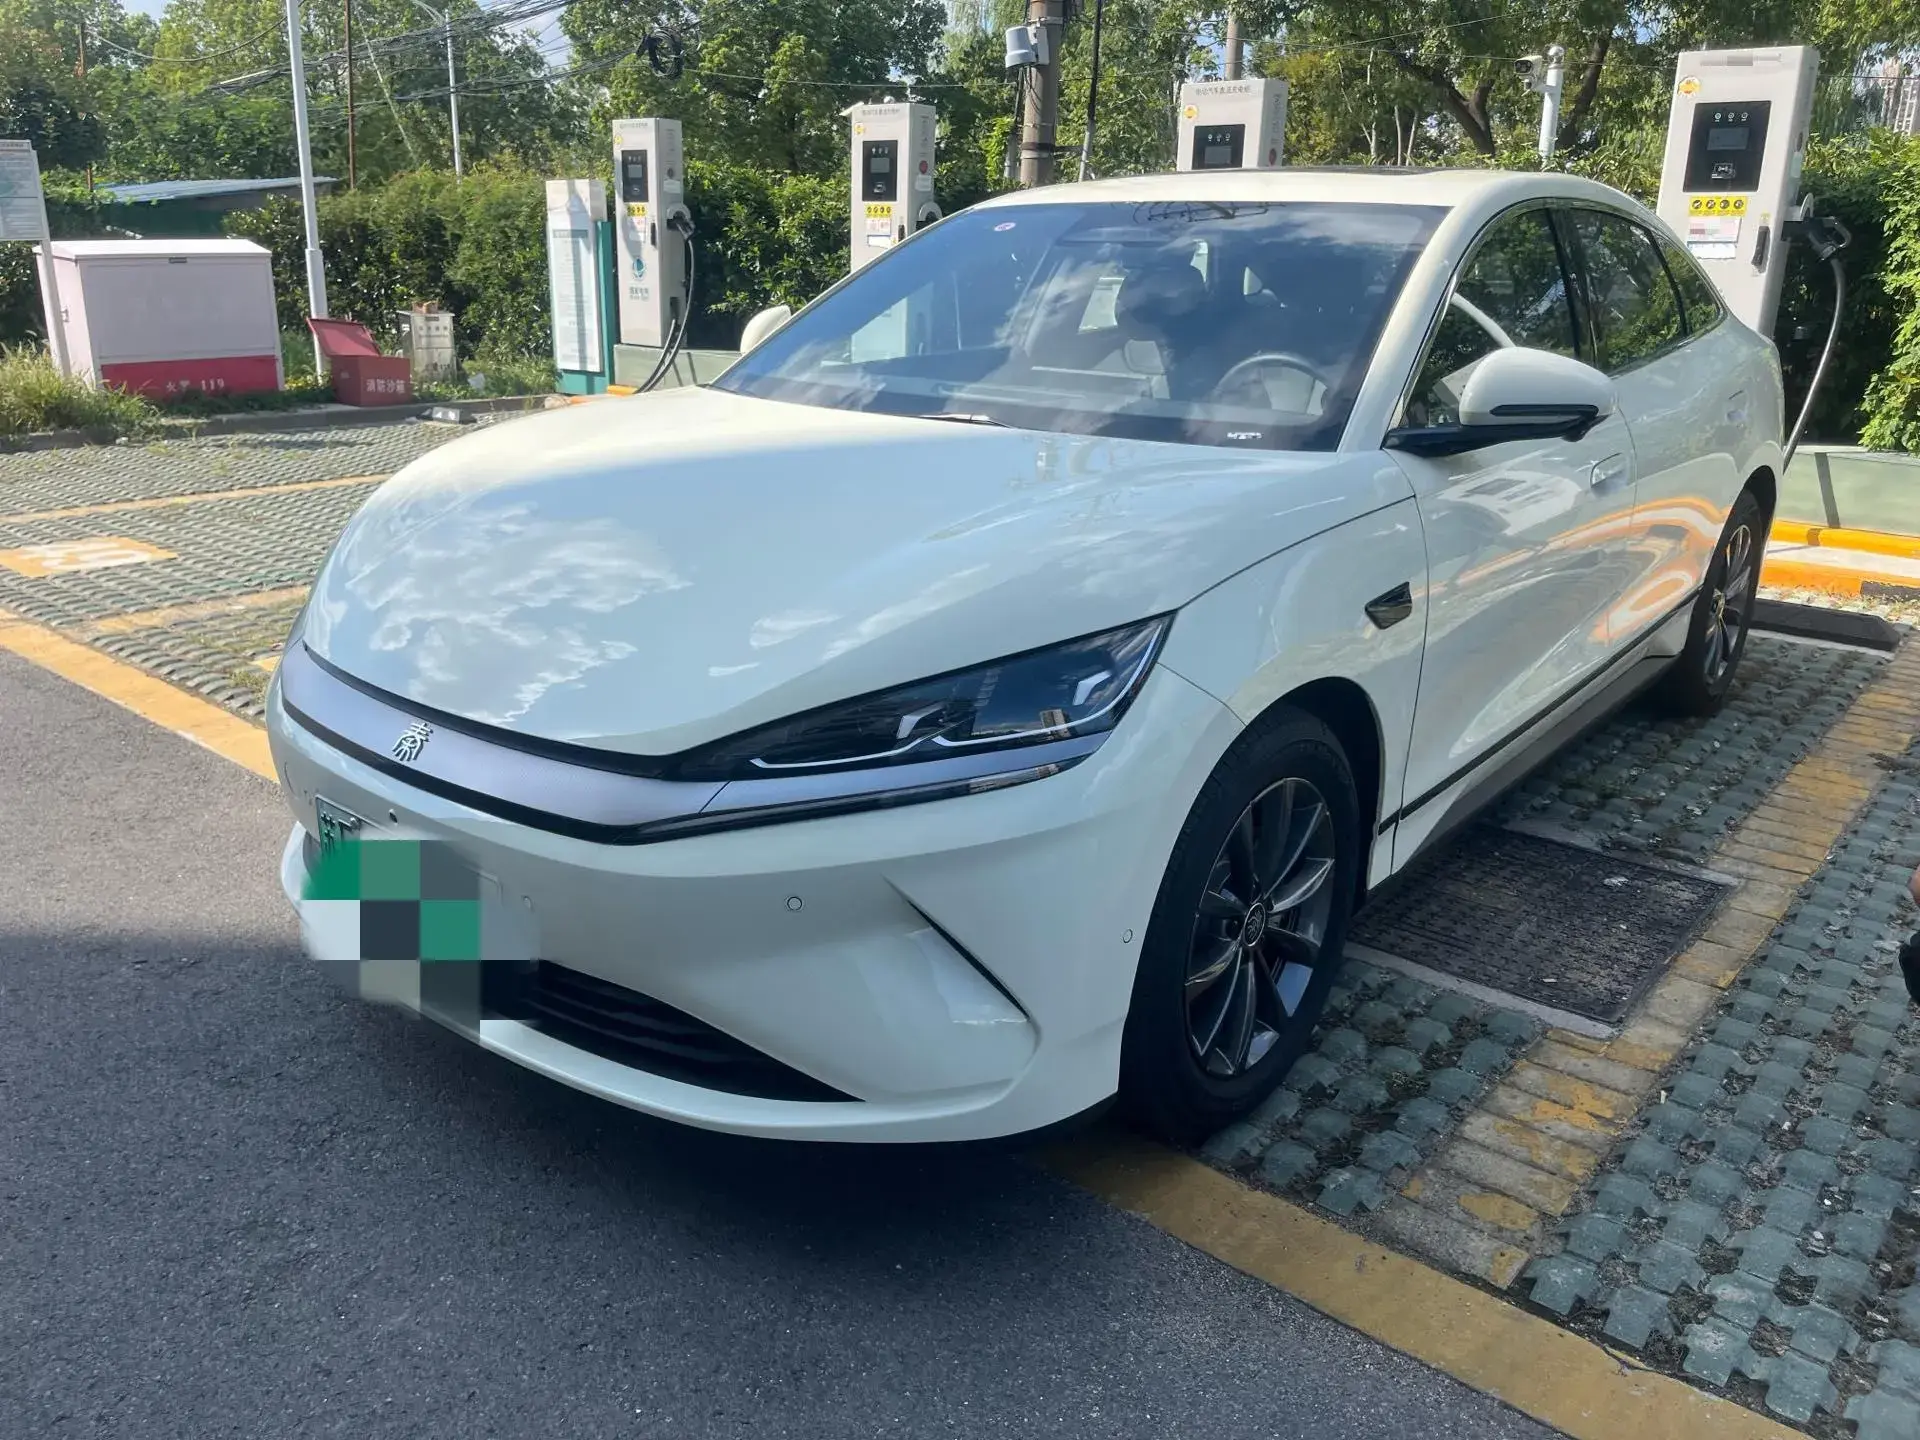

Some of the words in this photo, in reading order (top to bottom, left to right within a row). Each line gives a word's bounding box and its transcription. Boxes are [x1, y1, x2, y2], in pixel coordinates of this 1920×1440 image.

[201, 378, 225, 391] 119
[366, 378, 406, 394] 消防沙箱
